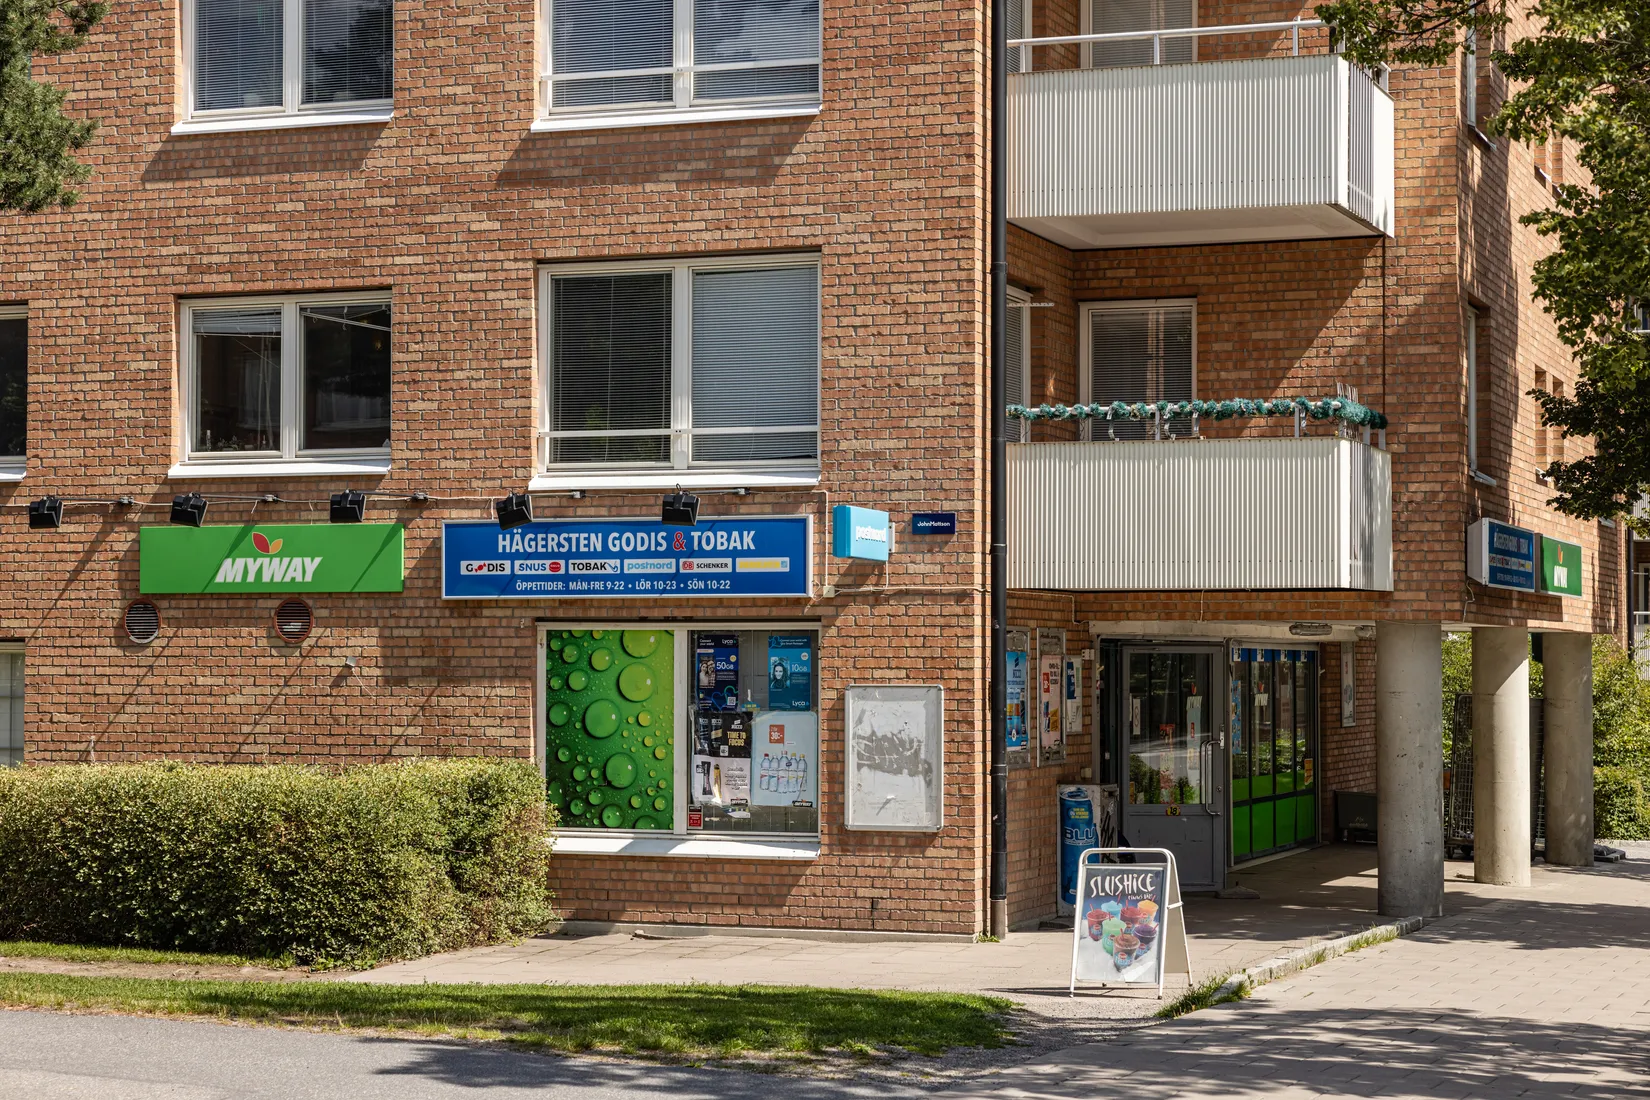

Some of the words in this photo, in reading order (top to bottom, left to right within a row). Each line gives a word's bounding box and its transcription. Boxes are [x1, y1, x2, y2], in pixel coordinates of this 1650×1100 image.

[498, 529, 602, 553] HÄGERSTEN
[608, 532, 667, 551] GODIS
[673, 531, 686, 551] &
[691, 530, 756, 551] TOBAK
[214, 557, 323, 583] MYWAY
[518, 562, 547, 572] SNUS
[571, 562, 607, 571] TOBAK
[627, 561, 673, 571] postnord
[516, 580, 565, 591] ÖPPETTIDER:
[569, 579, 605, 591] MÅN-FRE
[606, 581, 625, 590] 9-22
[635, 579, 651, 590] LÖR
[653, 580, 677, 590] 10-23
[687, 579, 705, 590] SÖN
[706, 580, 730, 589] 10-22
[727, 731, 739, 739] TIME
[1169, 806, 1177, 816] 18
